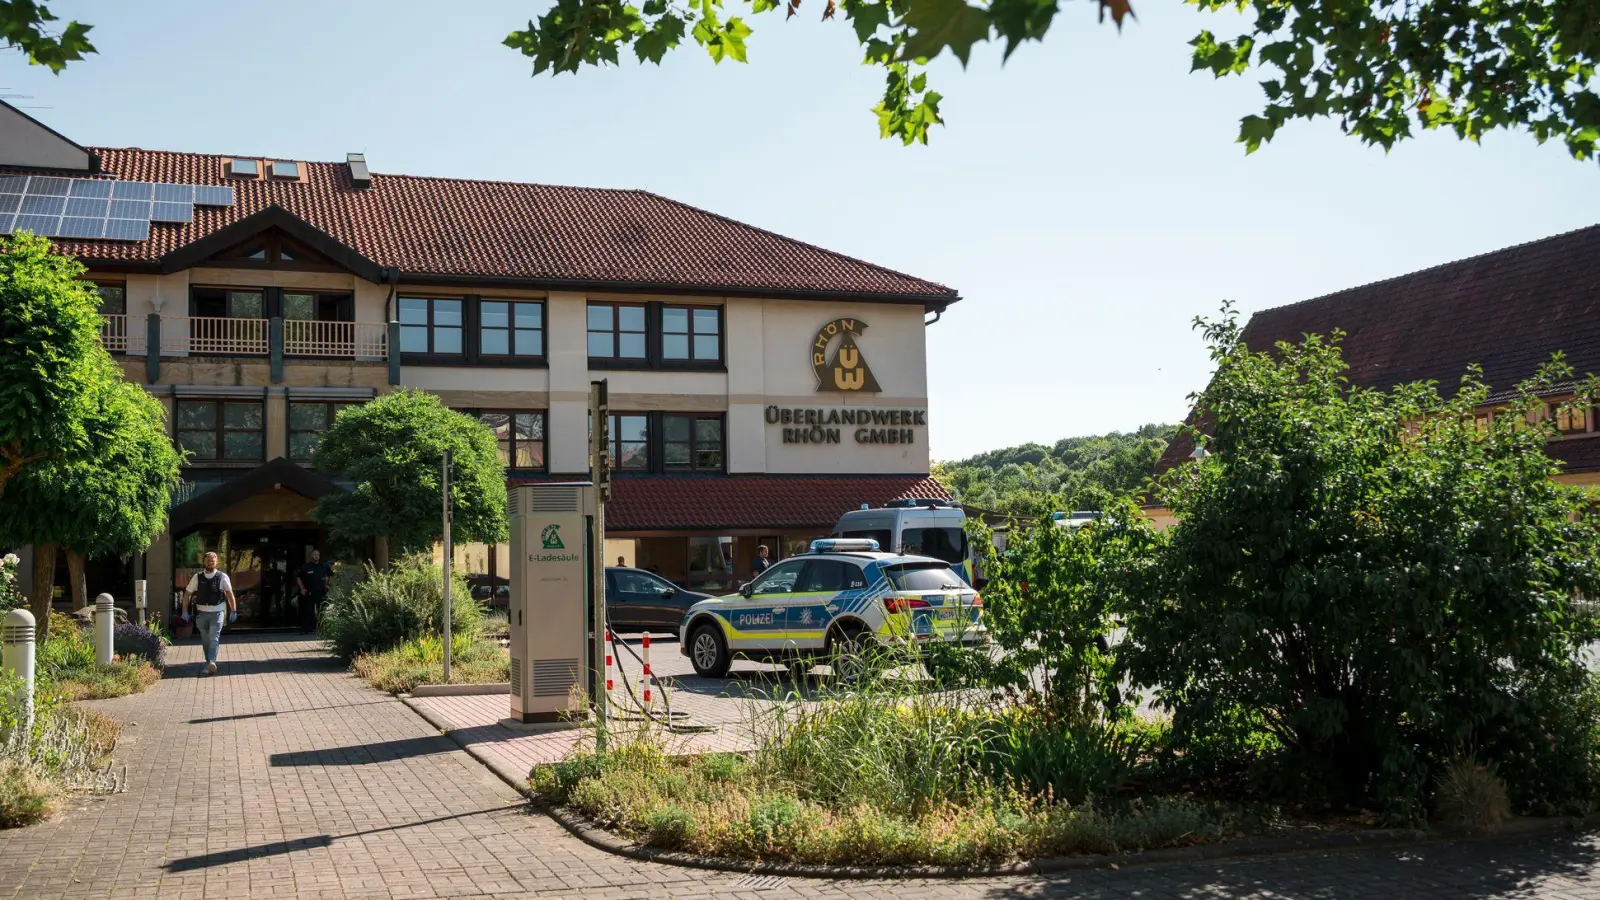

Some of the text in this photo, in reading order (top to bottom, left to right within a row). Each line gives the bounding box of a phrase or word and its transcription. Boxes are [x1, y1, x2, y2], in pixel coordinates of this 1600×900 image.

[813, 319, 855, 365] RHÖN
[765, 405, 926, 425] ÜBERLANDWERK
[782, 426, 913, 444] RHÖN GMBH
[528, 553, 579, 562] E-Ladesäule
[739, 613, 774, 625] POLIZEI
